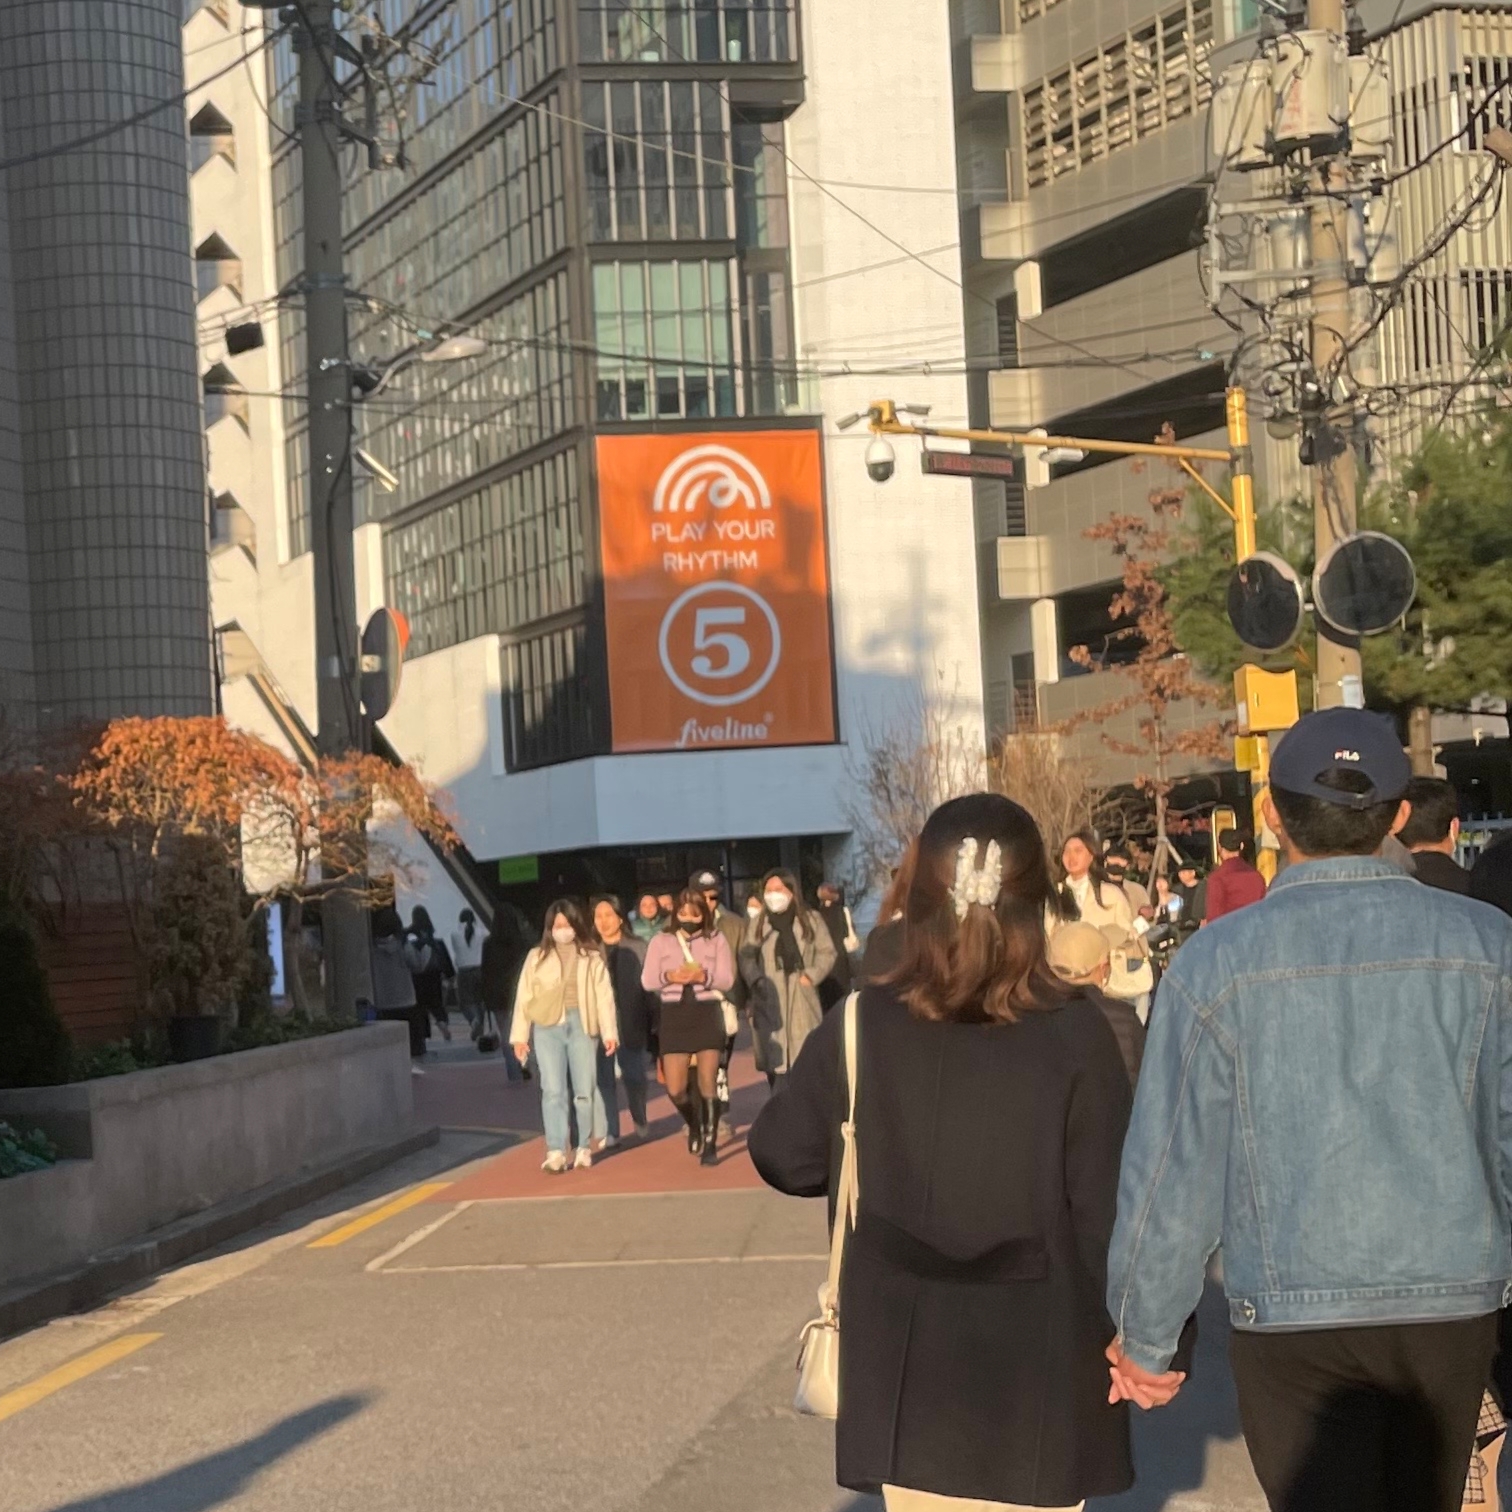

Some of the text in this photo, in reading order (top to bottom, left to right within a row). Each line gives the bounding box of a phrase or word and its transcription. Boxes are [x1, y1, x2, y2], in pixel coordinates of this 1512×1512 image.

[651, 519, 775, 543] PLAY YOUR
[663, 549, 758, 572] RHYTHM
[691, 606, 750, 679] 5
[1334, 748, 1360, 761] FILA
